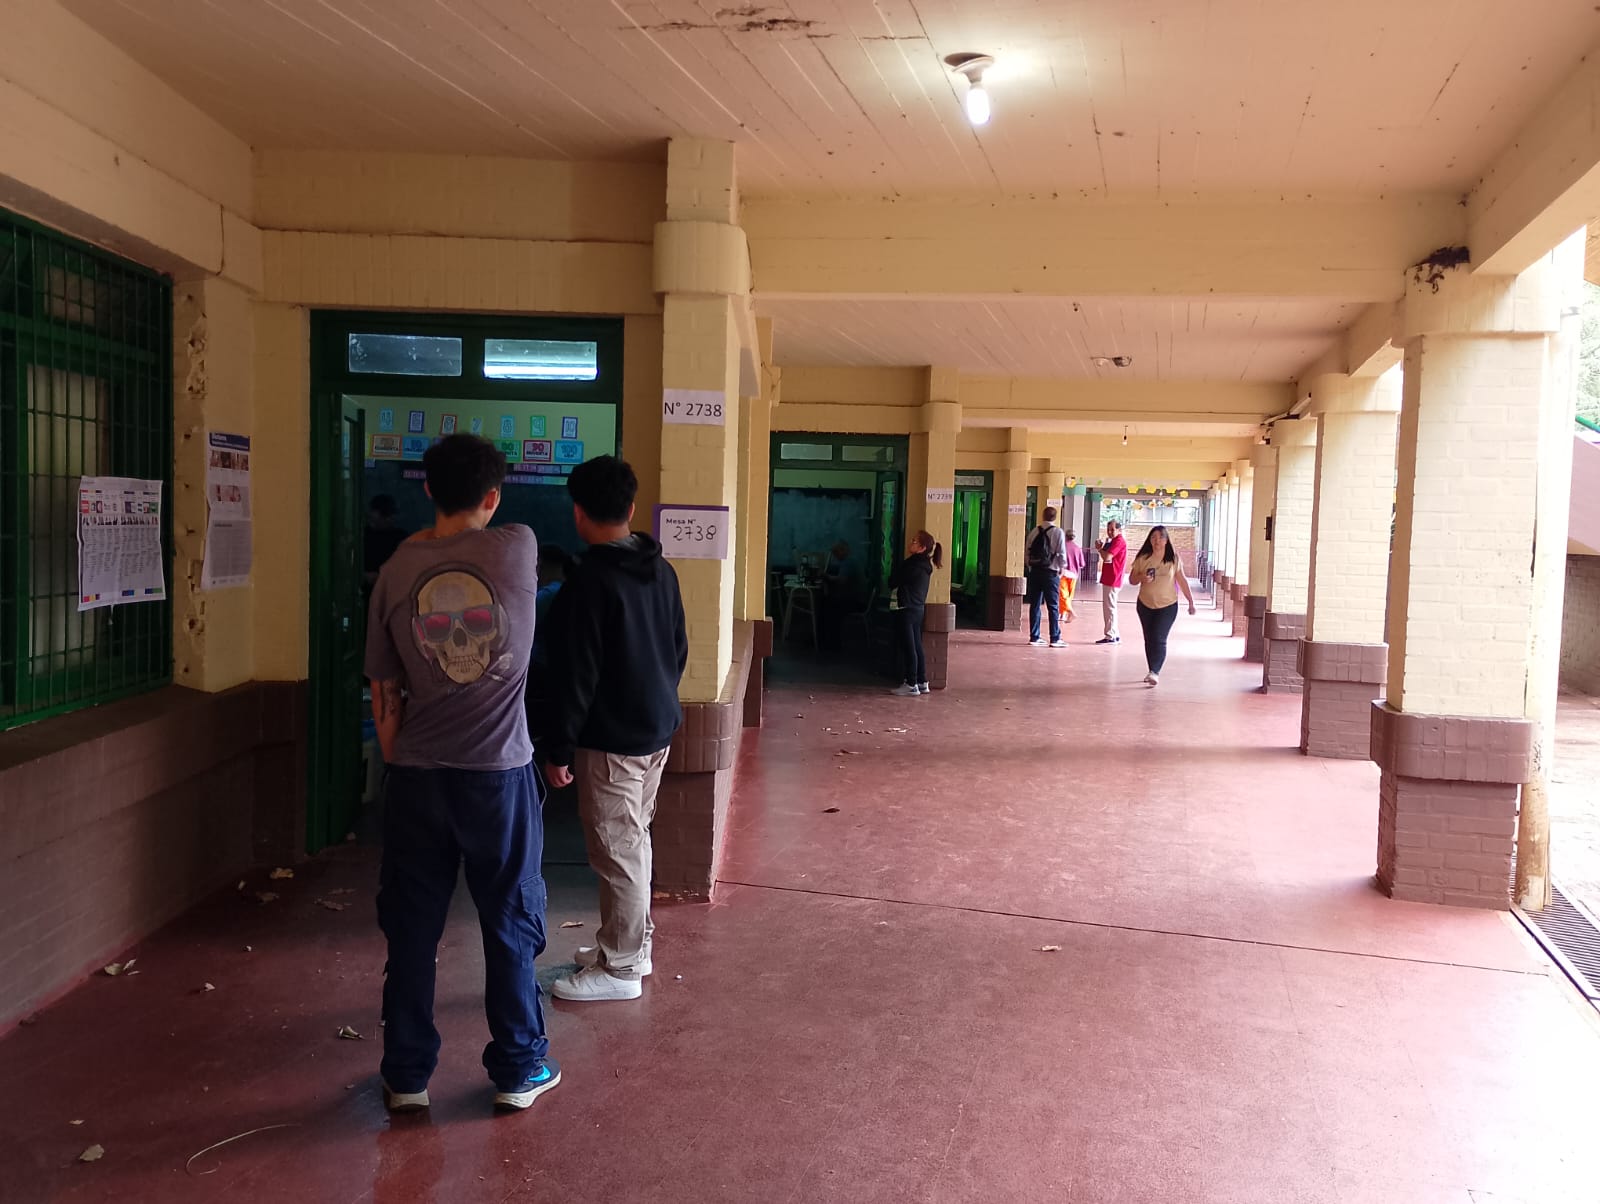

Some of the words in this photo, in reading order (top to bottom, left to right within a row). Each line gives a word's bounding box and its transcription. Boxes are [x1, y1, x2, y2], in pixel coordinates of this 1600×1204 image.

[664, 402, 681, 416] N°
[686, 403, 722, 417] 2738
[673, 525, 717, 541] 2738
